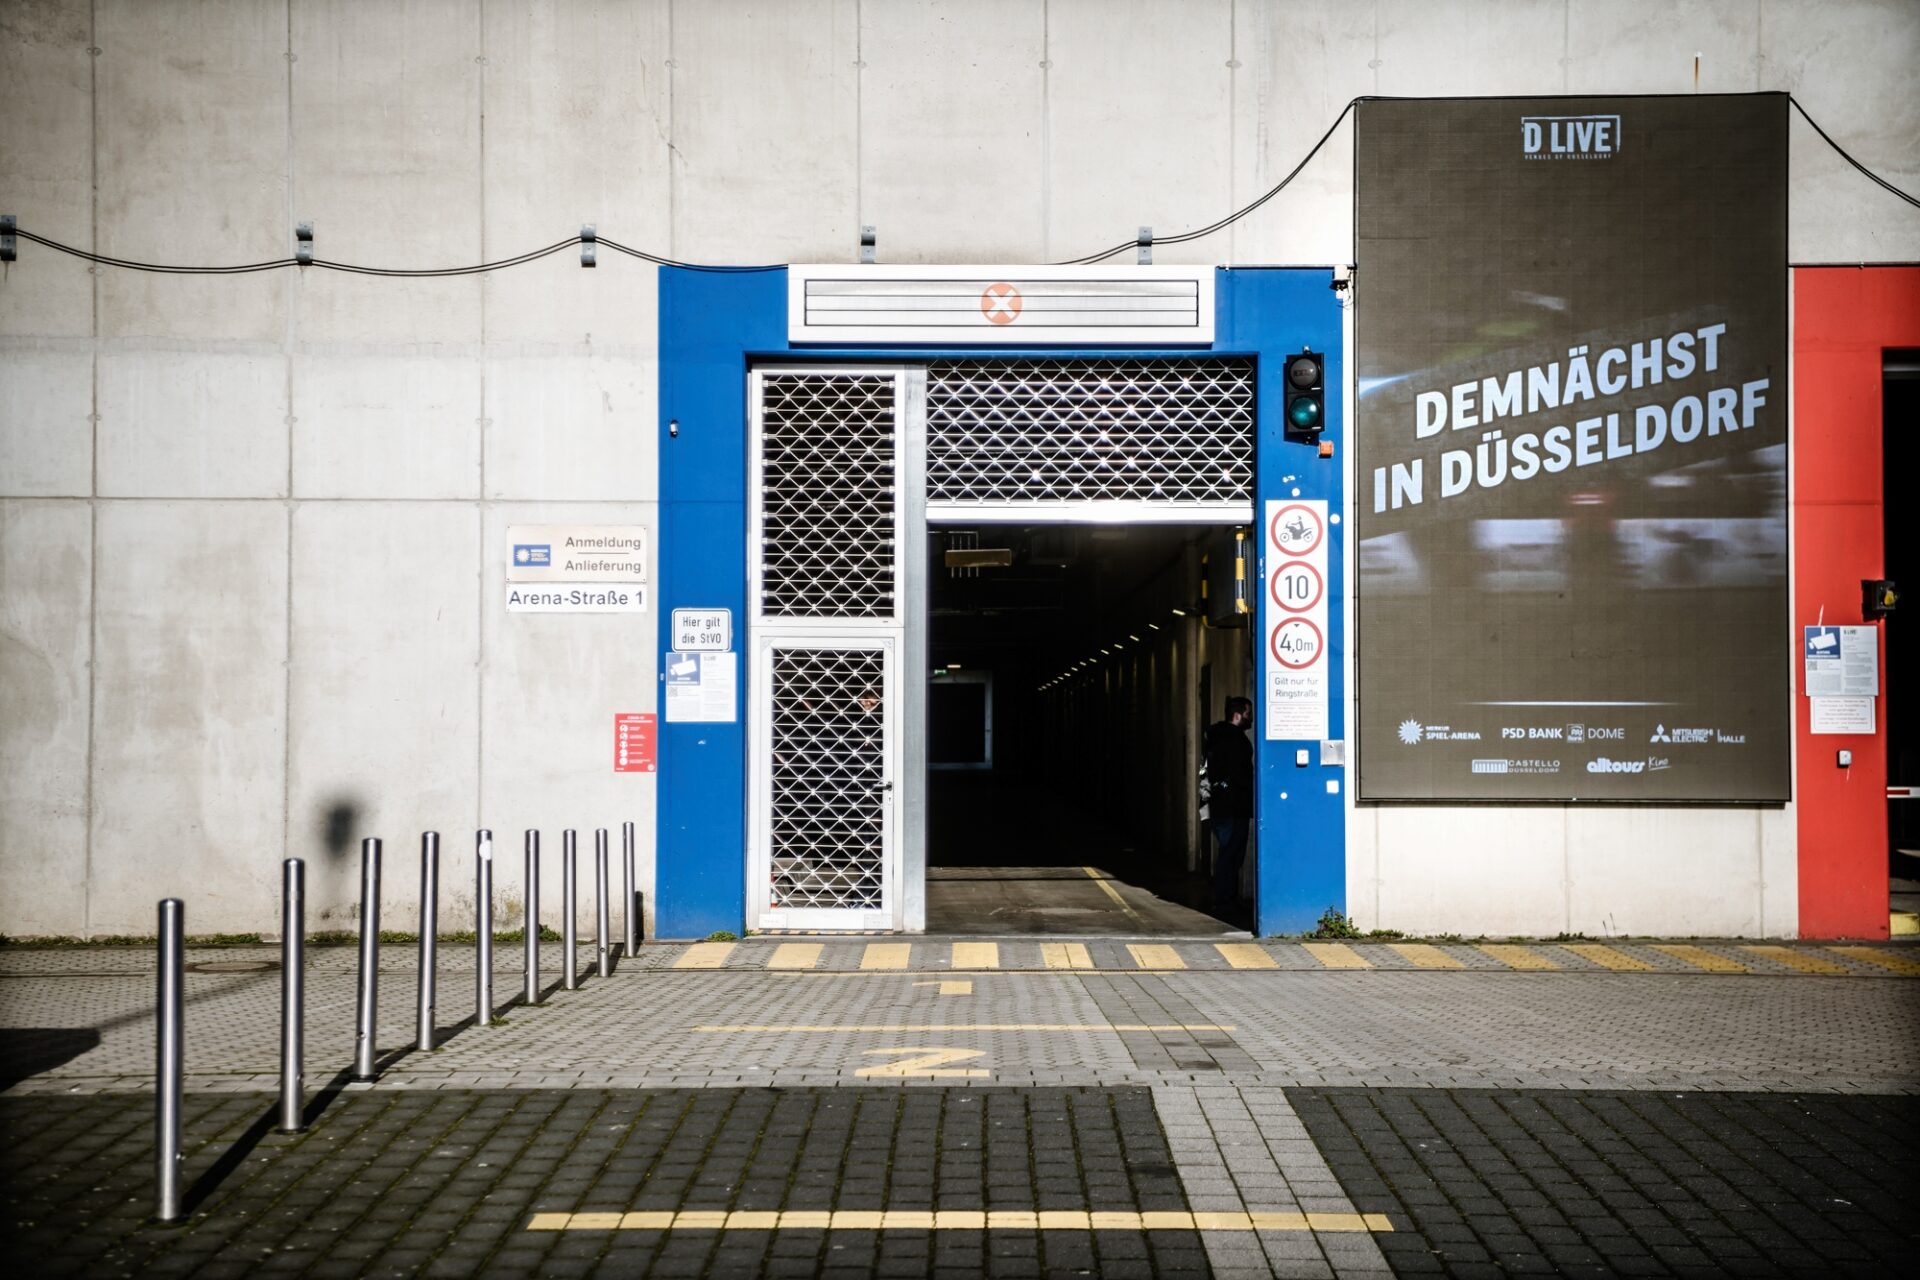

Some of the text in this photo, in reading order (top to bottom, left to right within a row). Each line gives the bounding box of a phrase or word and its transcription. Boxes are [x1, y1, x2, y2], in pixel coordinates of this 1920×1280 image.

[1524, 122, 1611, 153] D LIVE
[1416, 323, 1725, 439] DEMNÄCHST
[1374, 378, 1769, 514] IN DÜSSELDORF
[565, 537, 641, 550] Anmeldung
[565, 560, 641, 574] Anlieferung
[1284, 575, 1309, 600] 10
[509, 590, 643, 605] Arena-Straße 1
[682, 616, 721, 630] Hier gilt
[681, 633, 722, 644] die StVO
[1274, 677, 1289, 686] Gilt
[1290, 678, 1304, 686] nur
[1426, 732, 1481, 740] SPIEL-ARENA
[1502, 727, 1625, 739] PSD BANK DOME
[1508, 759, 1560, 767] CASTELLO
